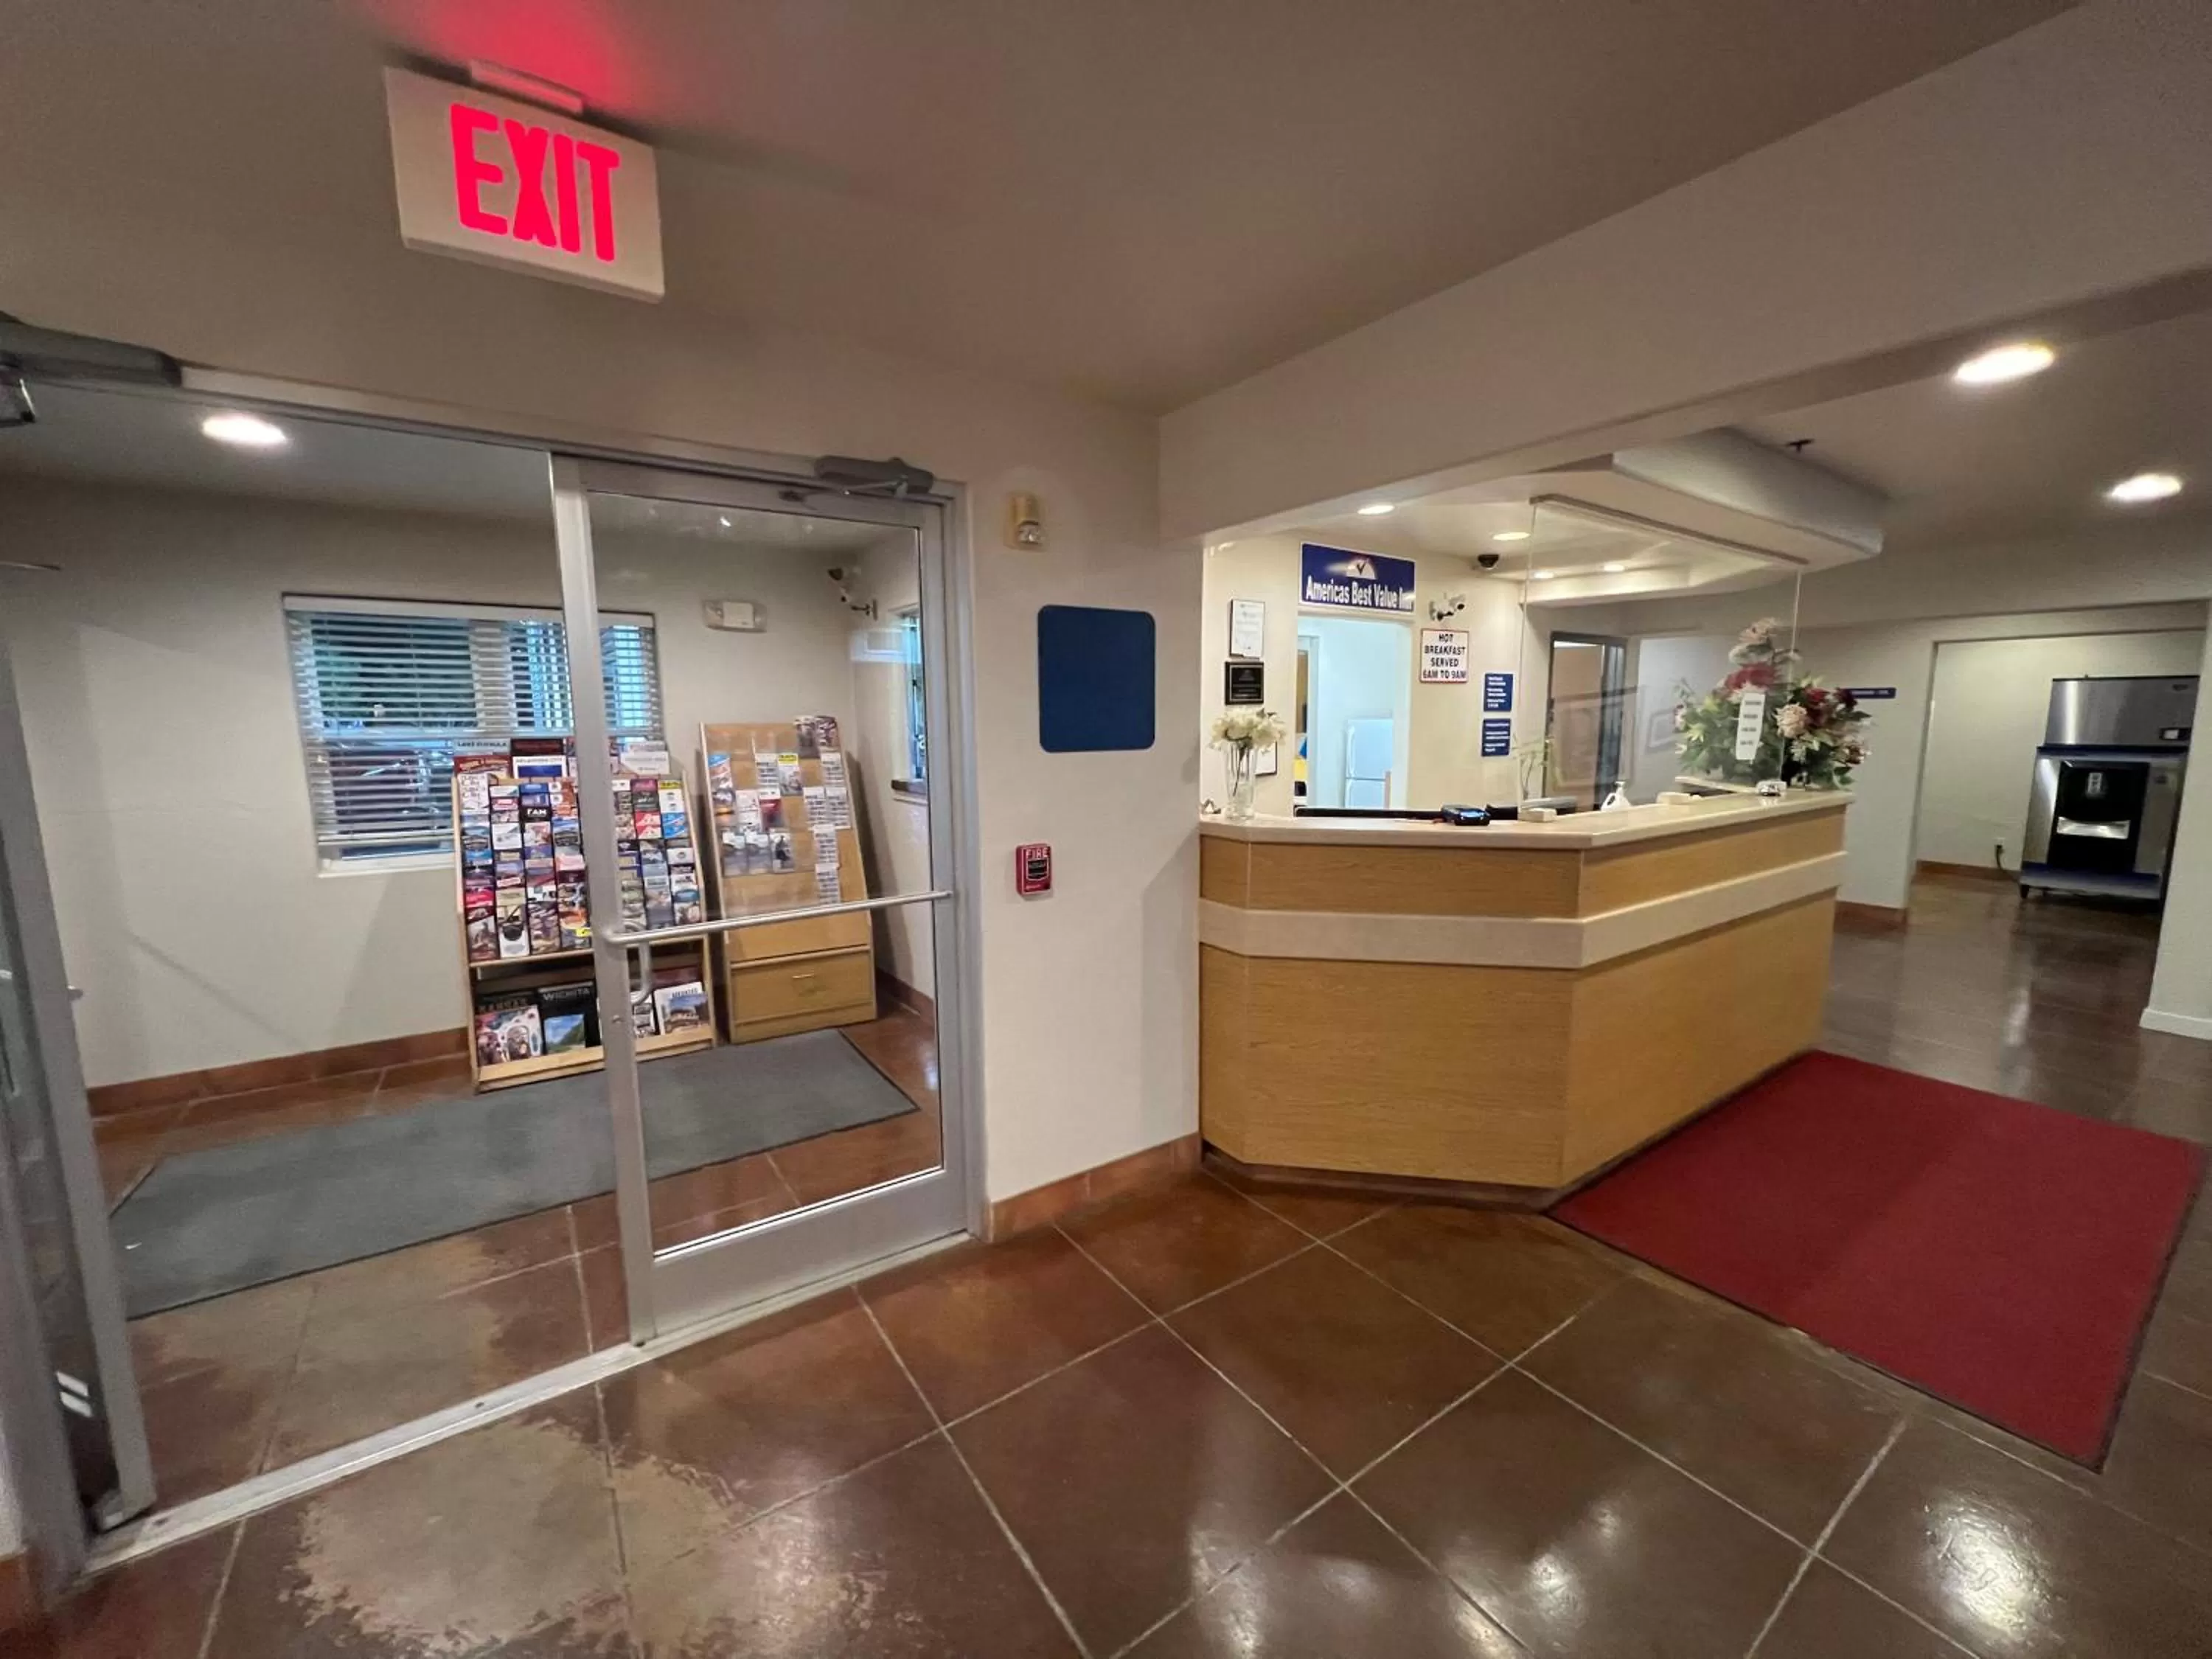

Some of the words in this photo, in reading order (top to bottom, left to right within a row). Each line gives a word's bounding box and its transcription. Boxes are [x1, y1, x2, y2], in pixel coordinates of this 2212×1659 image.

[450, 102, 620, 262] EXIT
[1306, 574, 1349, 604] Americas
[1351, 581, 1372, 607] Best
[1374, 583, 1398, 608] Value
[1439, 633, 1453, 643] HOT
[1425, 644, 1466, 655] BREAKFAST
[1430, 657, 1459, 667] SERVED
[1440, 669, 1450, 679] TO
